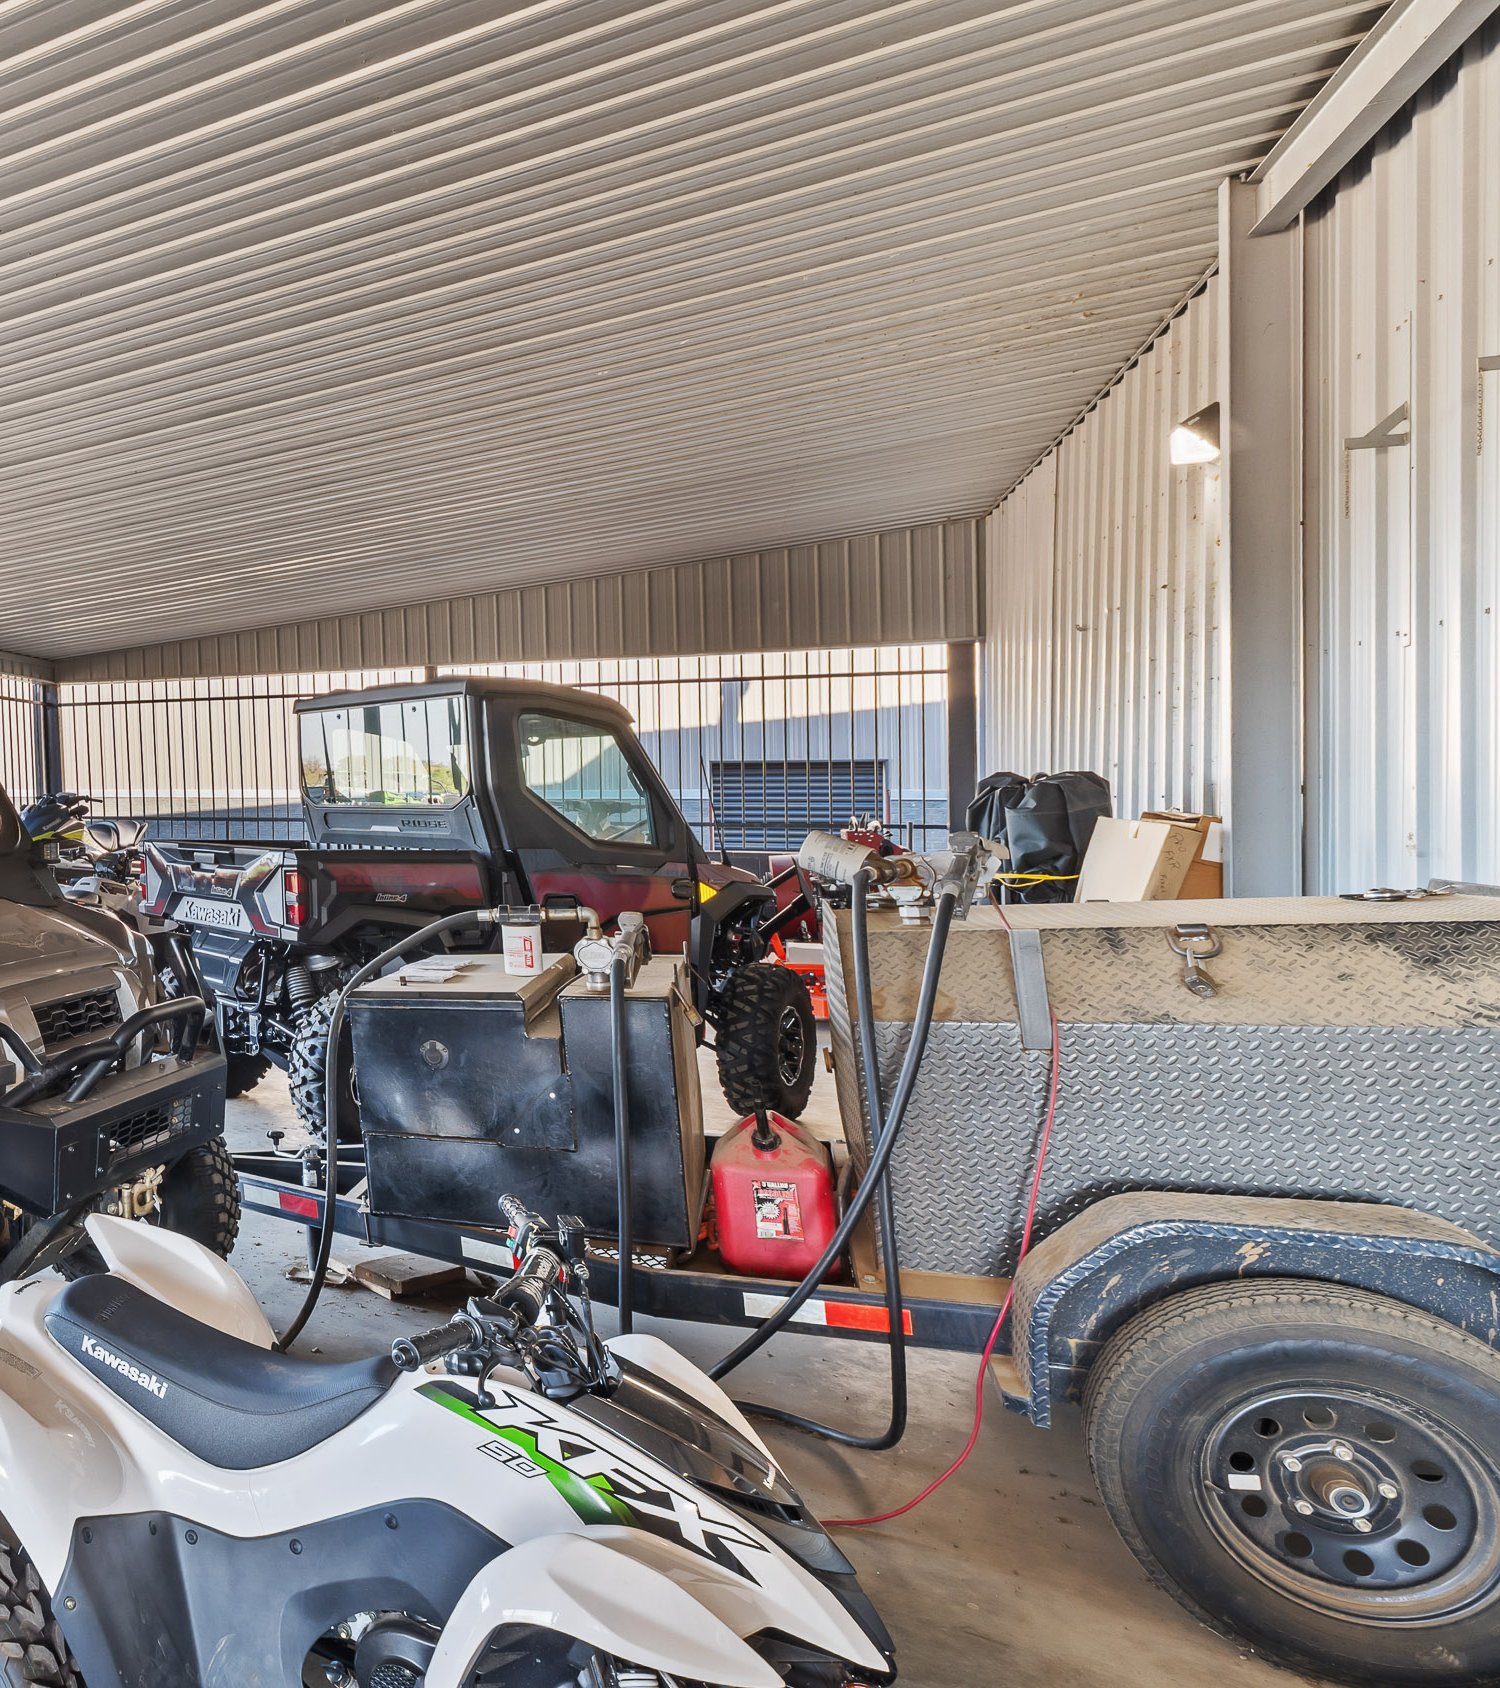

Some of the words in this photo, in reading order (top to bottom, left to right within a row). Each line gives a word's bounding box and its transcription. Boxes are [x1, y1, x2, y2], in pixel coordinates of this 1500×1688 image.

[400, 819, 448, 828] RIDGE
[185, 901, 241, 926] Kawasaki
[81, 1335, 168, 1399] Kawasaki
[474, 1390, 772, 1562] KFX
[476, 1440, 550, 1478] 50
